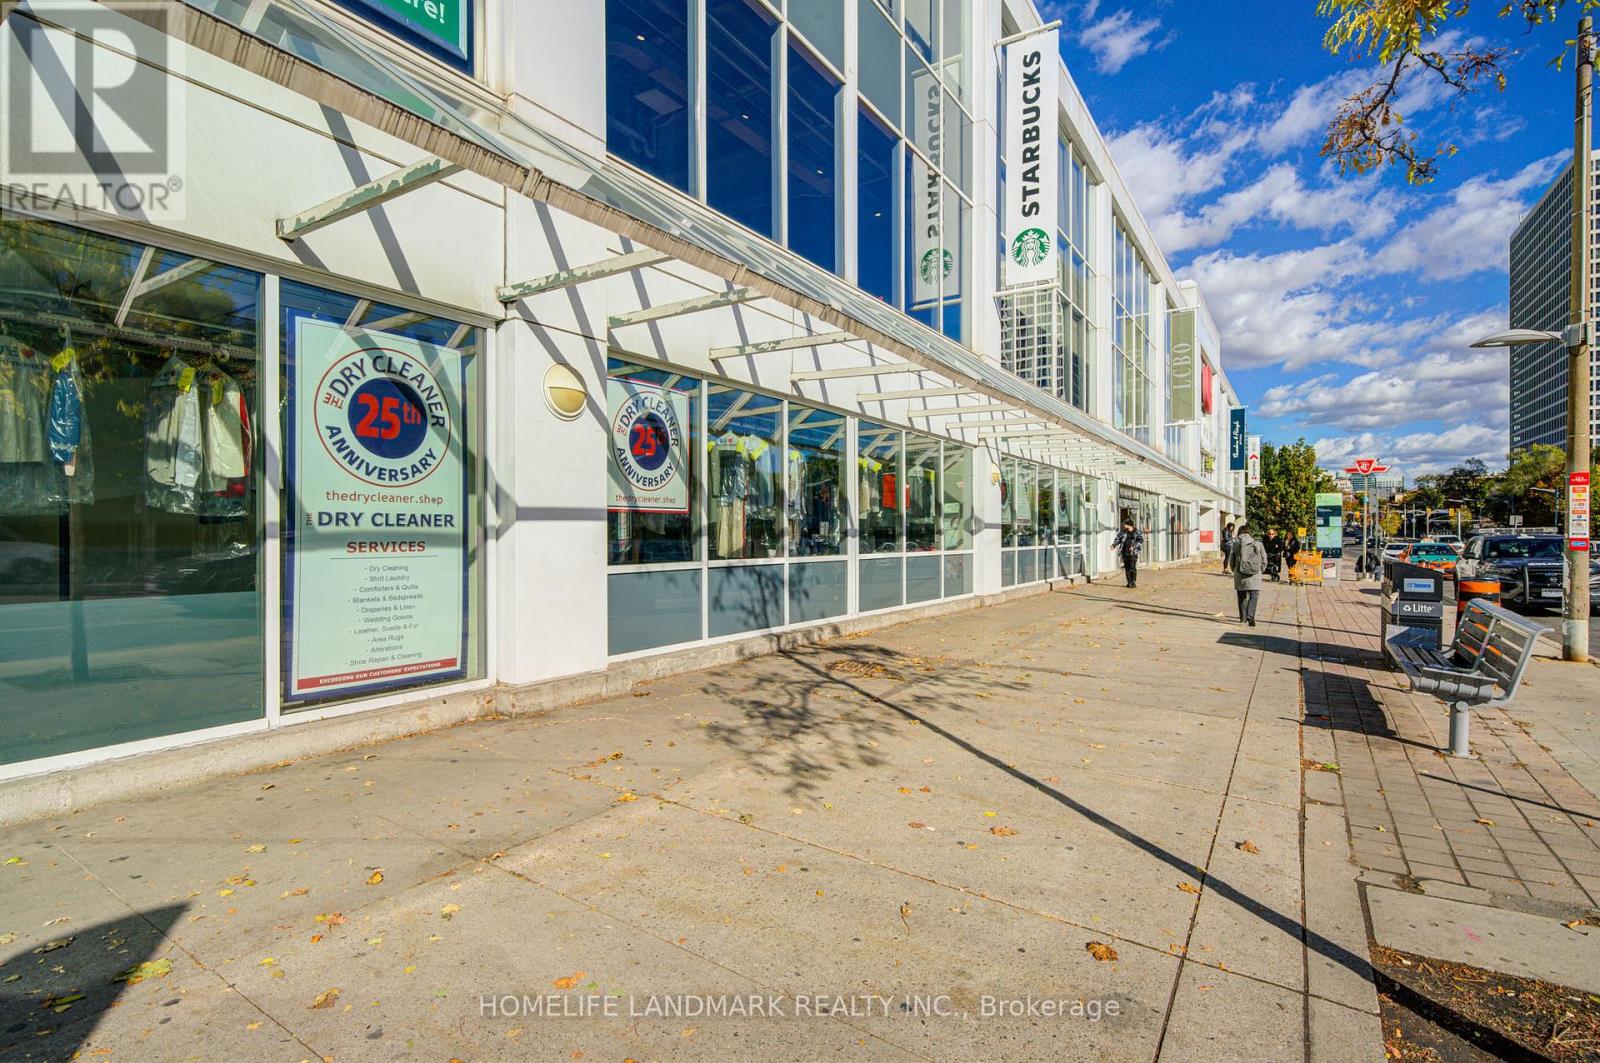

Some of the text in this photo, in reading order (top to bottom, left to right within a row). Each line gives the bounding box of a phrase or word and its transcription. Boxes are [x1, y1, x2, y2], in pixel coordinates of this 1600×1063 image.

[1022, 50, 1041, 218] STARBUCKS
[1173, 342, 1192, 390] LCBO
[323, 355, 446, 428] THE DRY CLEANER
[355, 392, 422, 440] 25th
[620, 398, 641, 428] DRY
[641, 396, 680, 447] CLEANER
[324, 424, 437, 482] ANNIVERSARY
[616, 447, 675, 488] ANNIVERSARY
[317, 511, 364, 527] DRY
[370, 512, 455, 528] CLEANER
[346, 540, 426, 553] SERVICES
[369, 564, 409, 573] Dry Cleaning
[385, 574, 410, 583] Laundry
[359, 585, 394, 593] Comforters
[352, 596, 381, 604] Blankets
[388, 593, 424, 602] Bedspreads
[361, 605, 392, 614] Draperies
[363, 616, 391, 624] Wedding
[388, 634, 404, 642] Rugs
[370, 644, 403, 653] Alterations
[350, 657, 367, 666] Shoe
[368, 655, 389, 664] Repair
[396, 651, 423, 660] Cleaning
[319, 675, 355, 684] EXCEEDING
[403, 662, 441, 672] EXPECTATIONS
